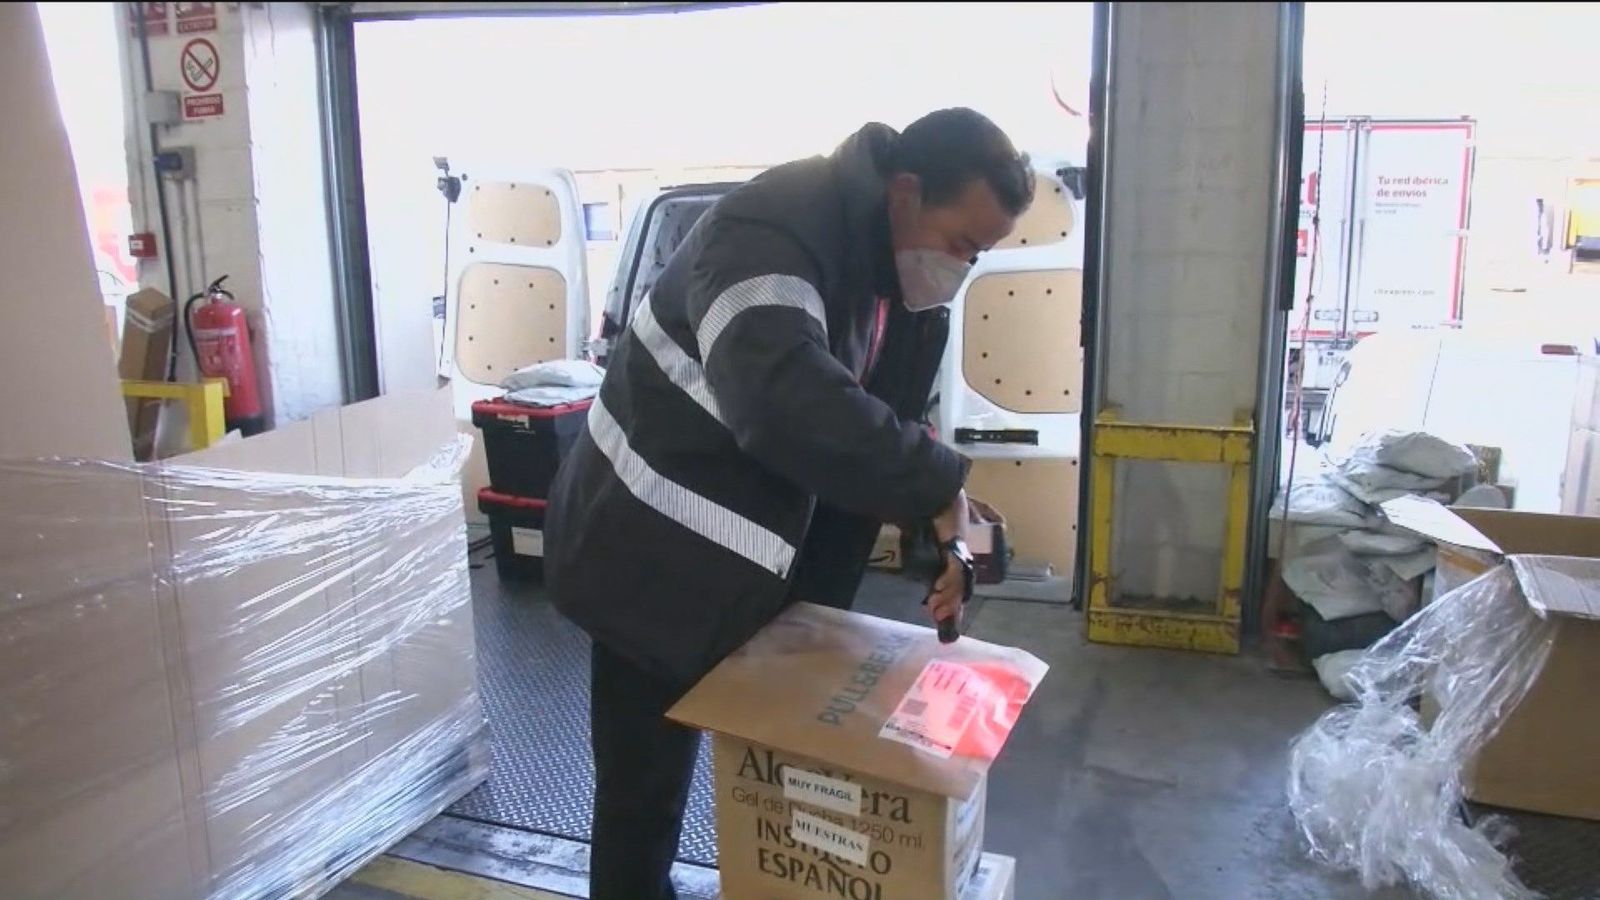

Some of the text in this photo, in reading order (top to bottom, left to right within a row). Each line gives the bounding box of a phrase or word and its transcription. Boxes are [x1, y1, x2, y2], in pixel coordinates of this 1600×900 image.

[1378, 176, 1390, 185] Tu
[1392, 176, 1410, 185] red
[1377, 188, 1390, 198] de
[788, 776, 811, 790] MUY
[732, 785, 758, 808] Gel
[764, 795, 784, 815] de
[795, 817, 864, 851] MUESTRAS
